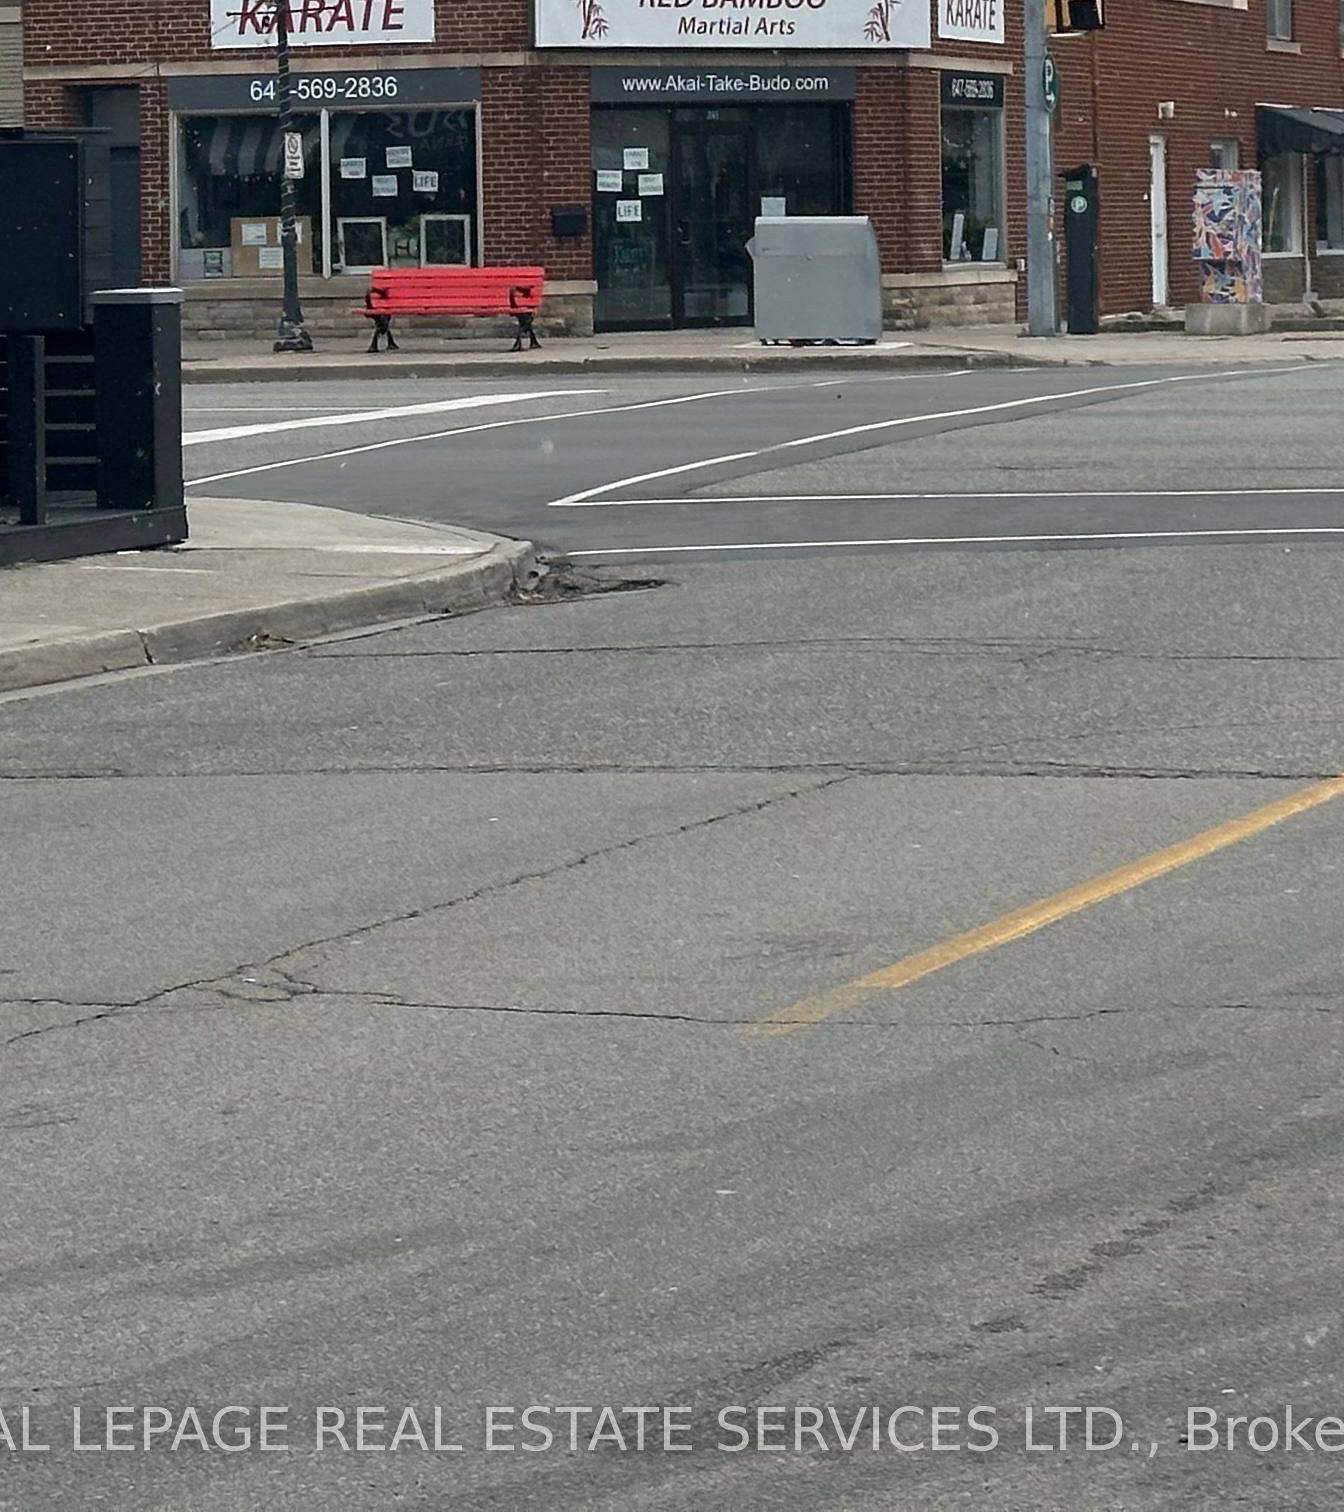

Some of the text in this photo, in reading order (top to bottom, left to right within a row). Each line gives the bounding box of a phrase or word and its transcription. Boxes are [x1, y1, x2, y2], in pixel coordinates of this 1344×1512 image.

[677, 16, 796, 35] Martial Arts
[250, 76, 398, 101] 64-569-2836
[415, 176, 437, 189] LIFE
[618, 204, 640, 218] LIFE
